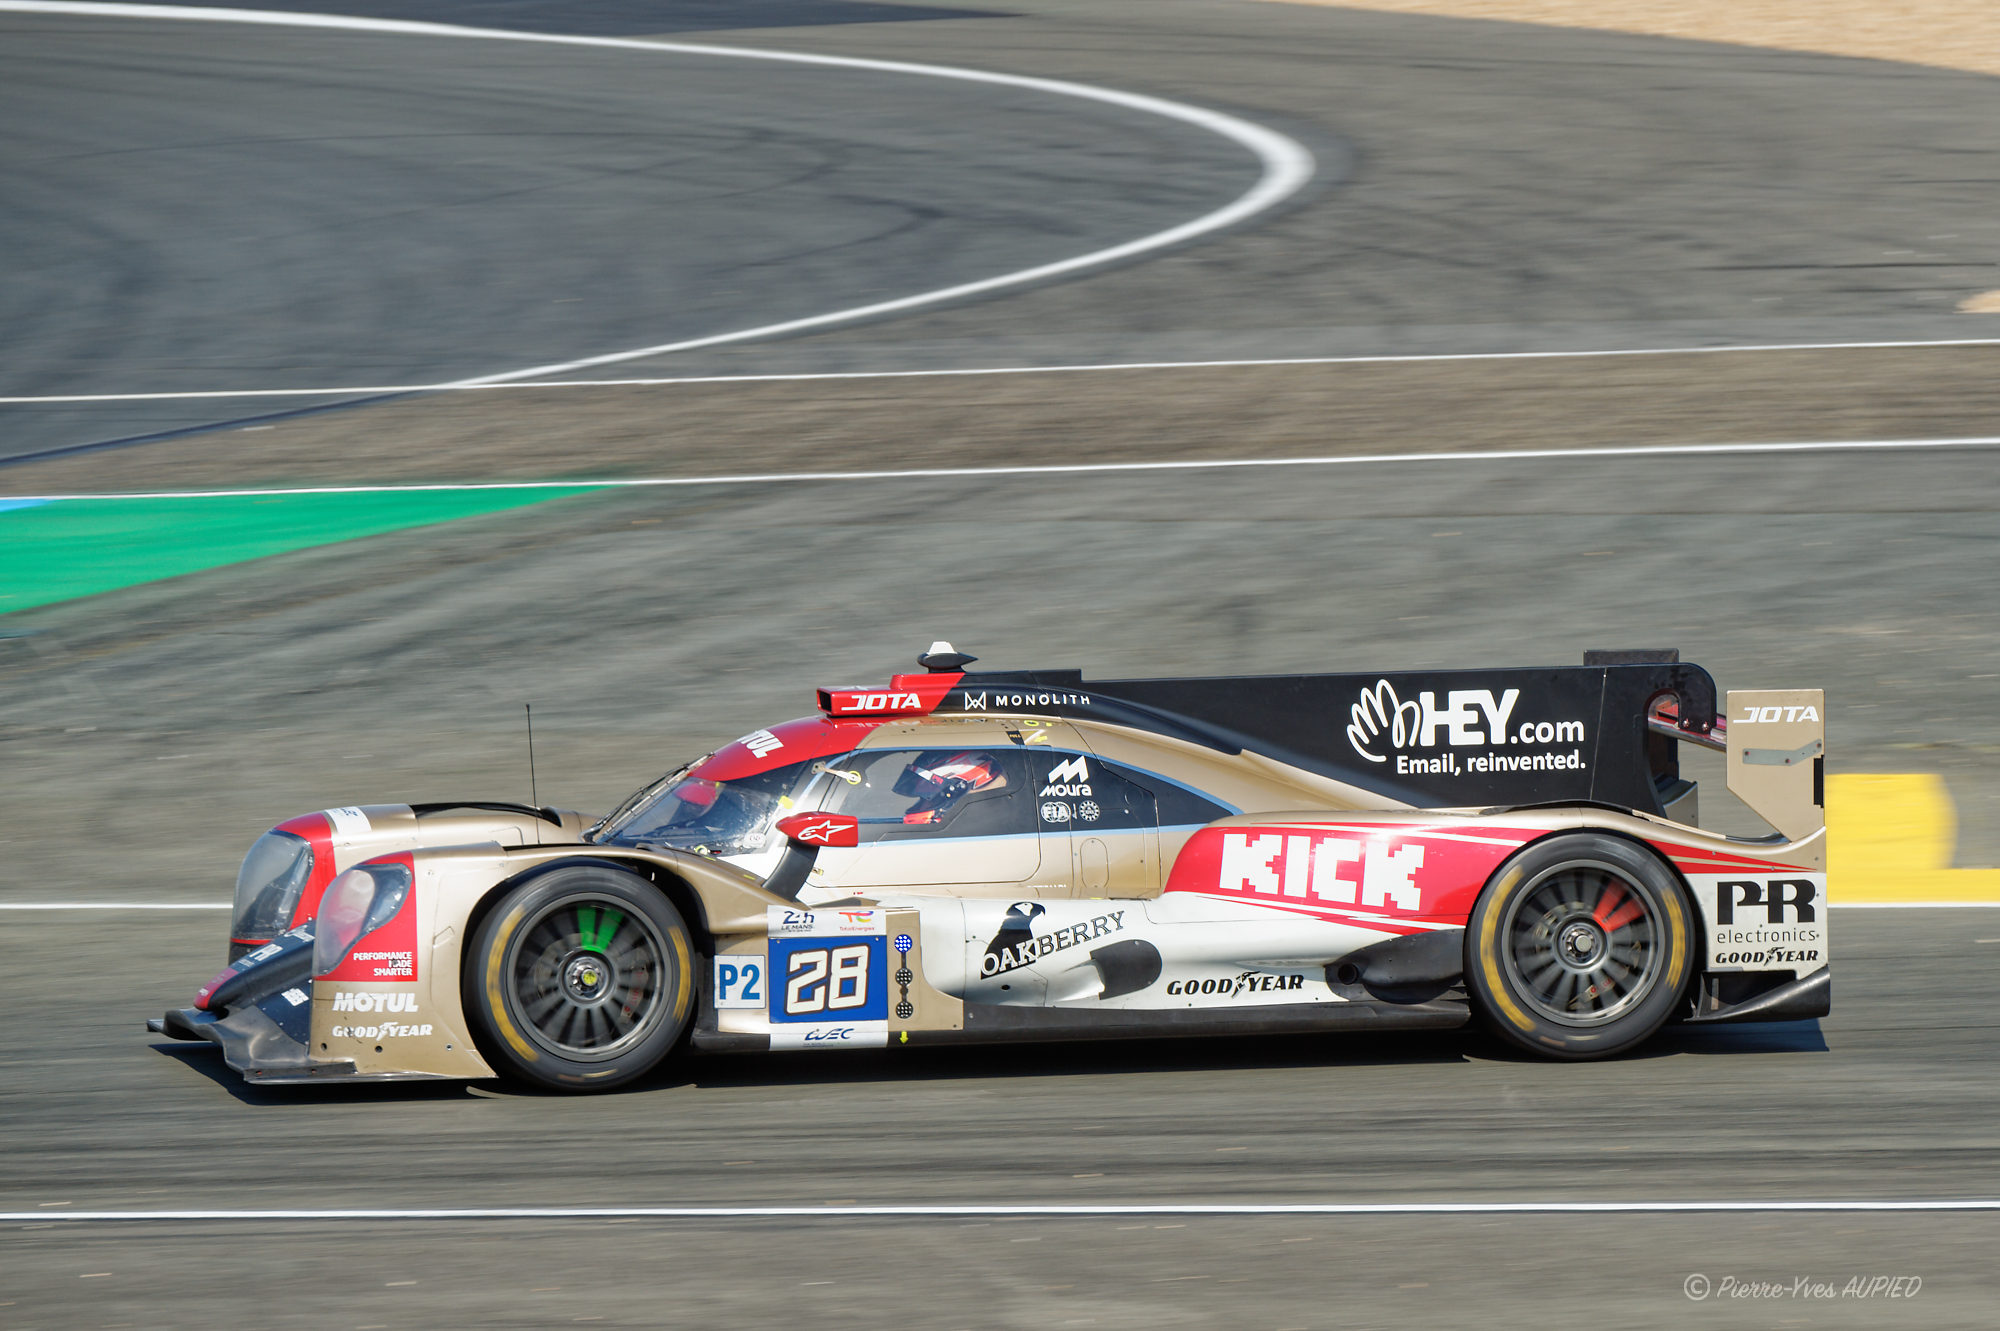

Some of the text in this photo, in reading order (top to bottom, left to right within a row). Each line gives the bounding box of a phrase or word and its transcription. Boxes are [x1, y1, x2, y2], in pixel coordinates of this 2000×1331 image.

[841, 693, 922, 711] JOTA
[995, 692, 1091, 707] MONOLITH
[1419, 688, 1585, 747] HEY.com
[1732, 705, 1820, 724] JOTA
[1396, 749, 1586, 776] Email, reinvented.
[1219, 833, 1425, 911] KICK
[1717, 879, 1816, 925] PR
[980, 910, 1125, 977] OAKBERRY
[1717, 927, 1816, 944] electronics
[353, 951, 413, 961] PERFORMANCE
[373, 967, 413, 976] SMARTER
[718, 963, 760, 1000] P2
[784, 943, 870, 1016] 28
[332, 992, 419, 1012] MOTUL
